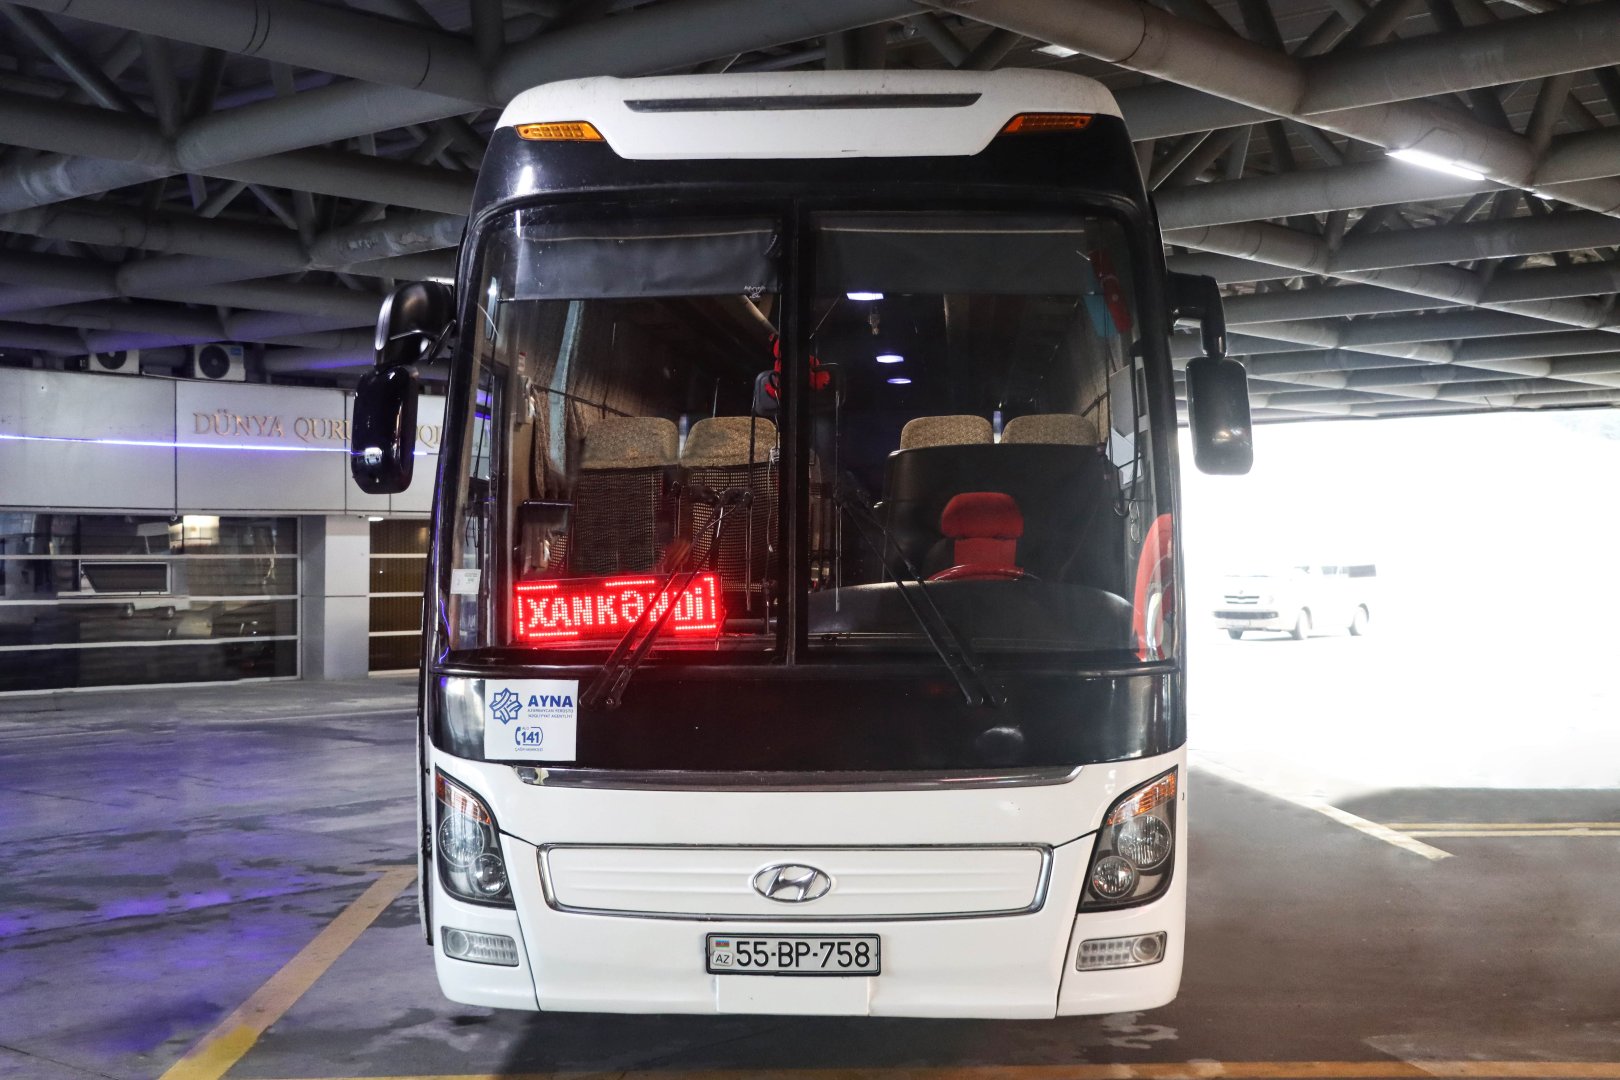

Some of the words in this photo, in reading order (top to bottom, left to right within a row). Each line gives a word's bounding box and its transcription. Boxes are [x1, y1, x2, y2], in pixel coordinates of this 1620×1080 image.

[193, 408, 285, 438] DÜNYA
[527, 695, 574, 708] AYNA
[521, 731, 539, 743] 141
[715, 954, 730, 964] AZ
[736, 941, 870, 968] 55-BP-758
